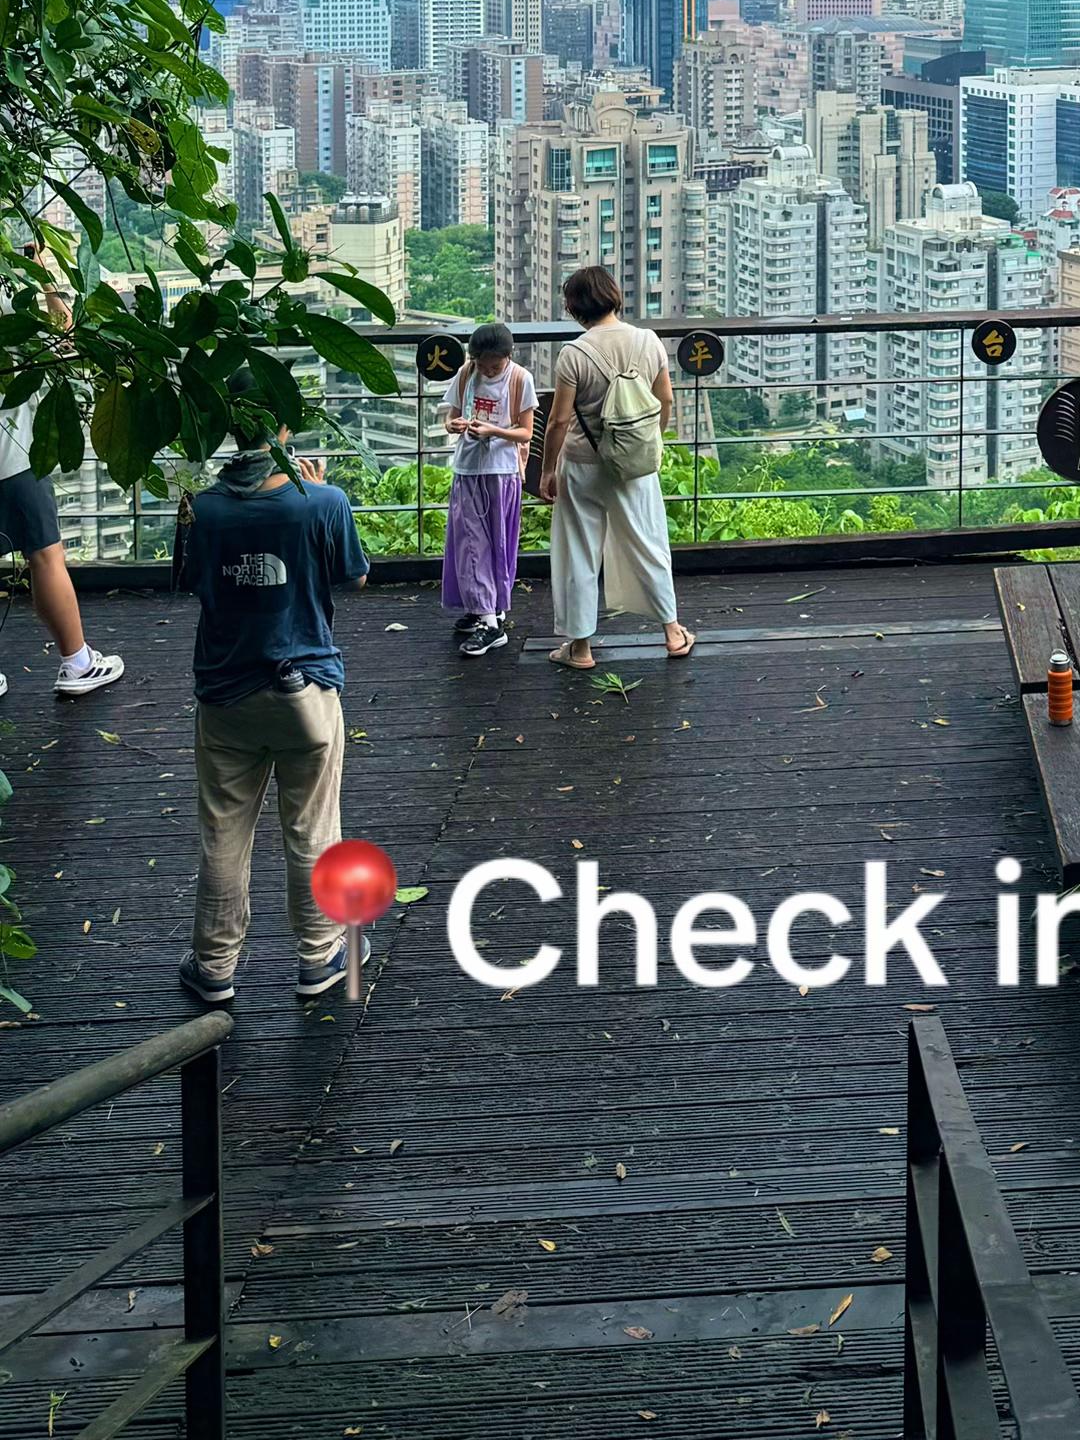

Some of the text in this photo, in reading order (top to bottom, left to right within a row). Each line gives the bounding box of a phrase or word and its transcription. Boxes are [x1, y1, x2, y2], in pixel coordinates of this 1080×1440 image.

[982, 329, 1004, 357] 台
[426, 343, 454, 372] 火
[240, 553, 263, 565] THE
[222, 564, 263, 576] NORTH
[236, 574, 263, 586] FACE
